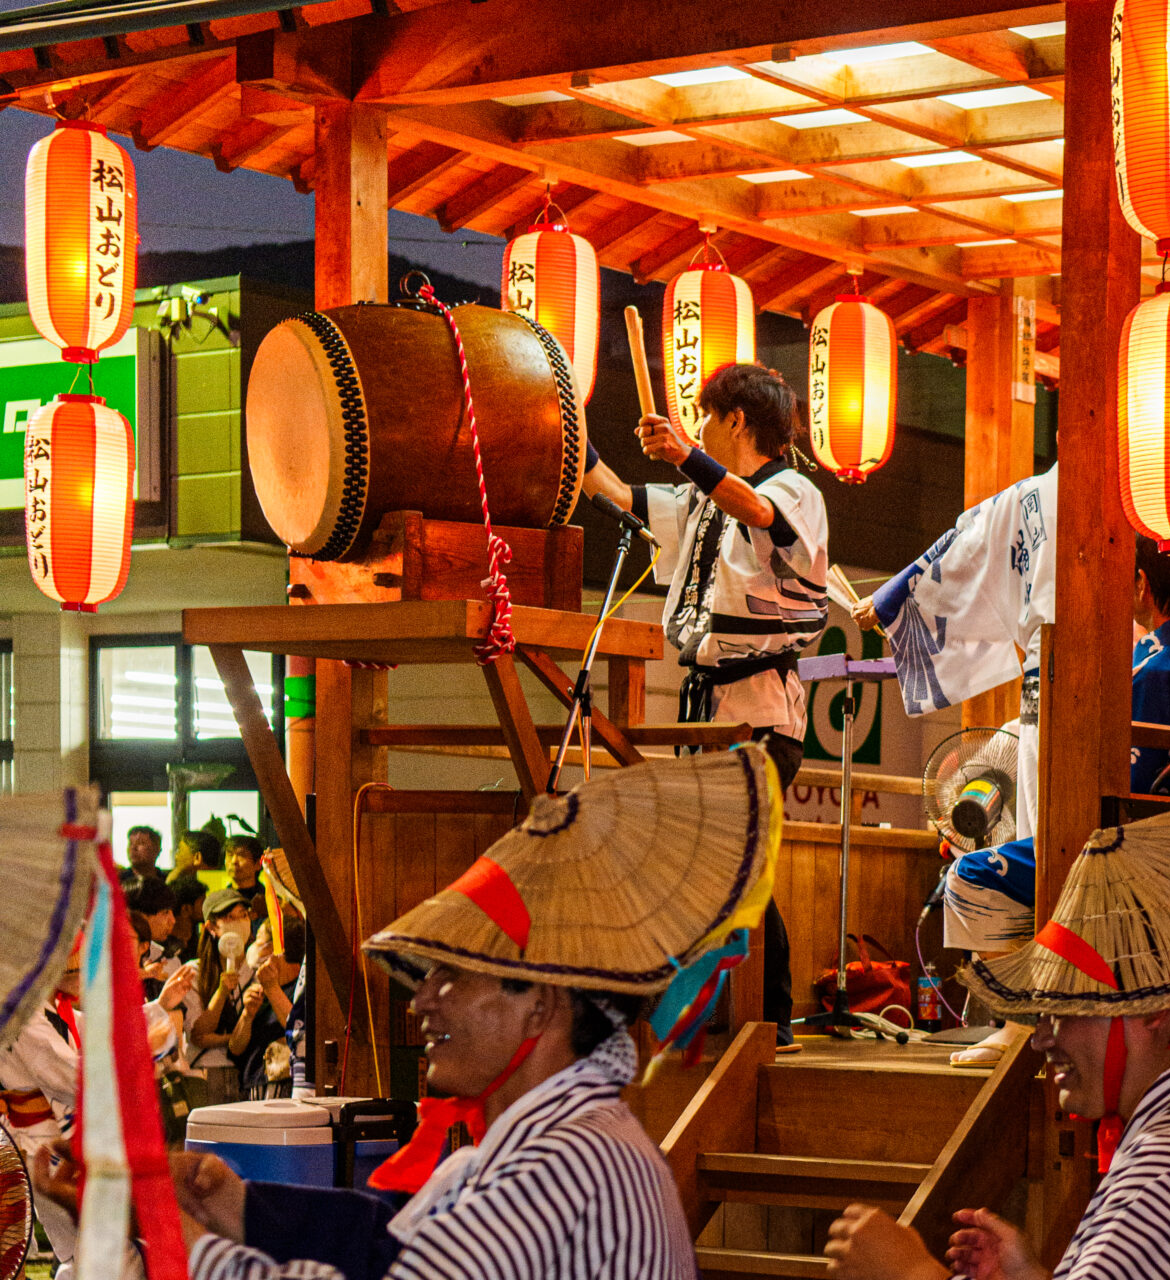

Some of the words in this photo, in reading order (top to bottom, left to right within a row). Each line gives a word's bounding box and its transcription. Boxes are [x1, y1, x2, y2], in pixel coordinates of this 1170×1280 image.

[92, 158, 125, 322] 松山おどり
[673, 299, 701, 425] 松山おどり
[810, 325, 829, 449] 松山おどり
[26, 436, 51, 580] 松山おどり
